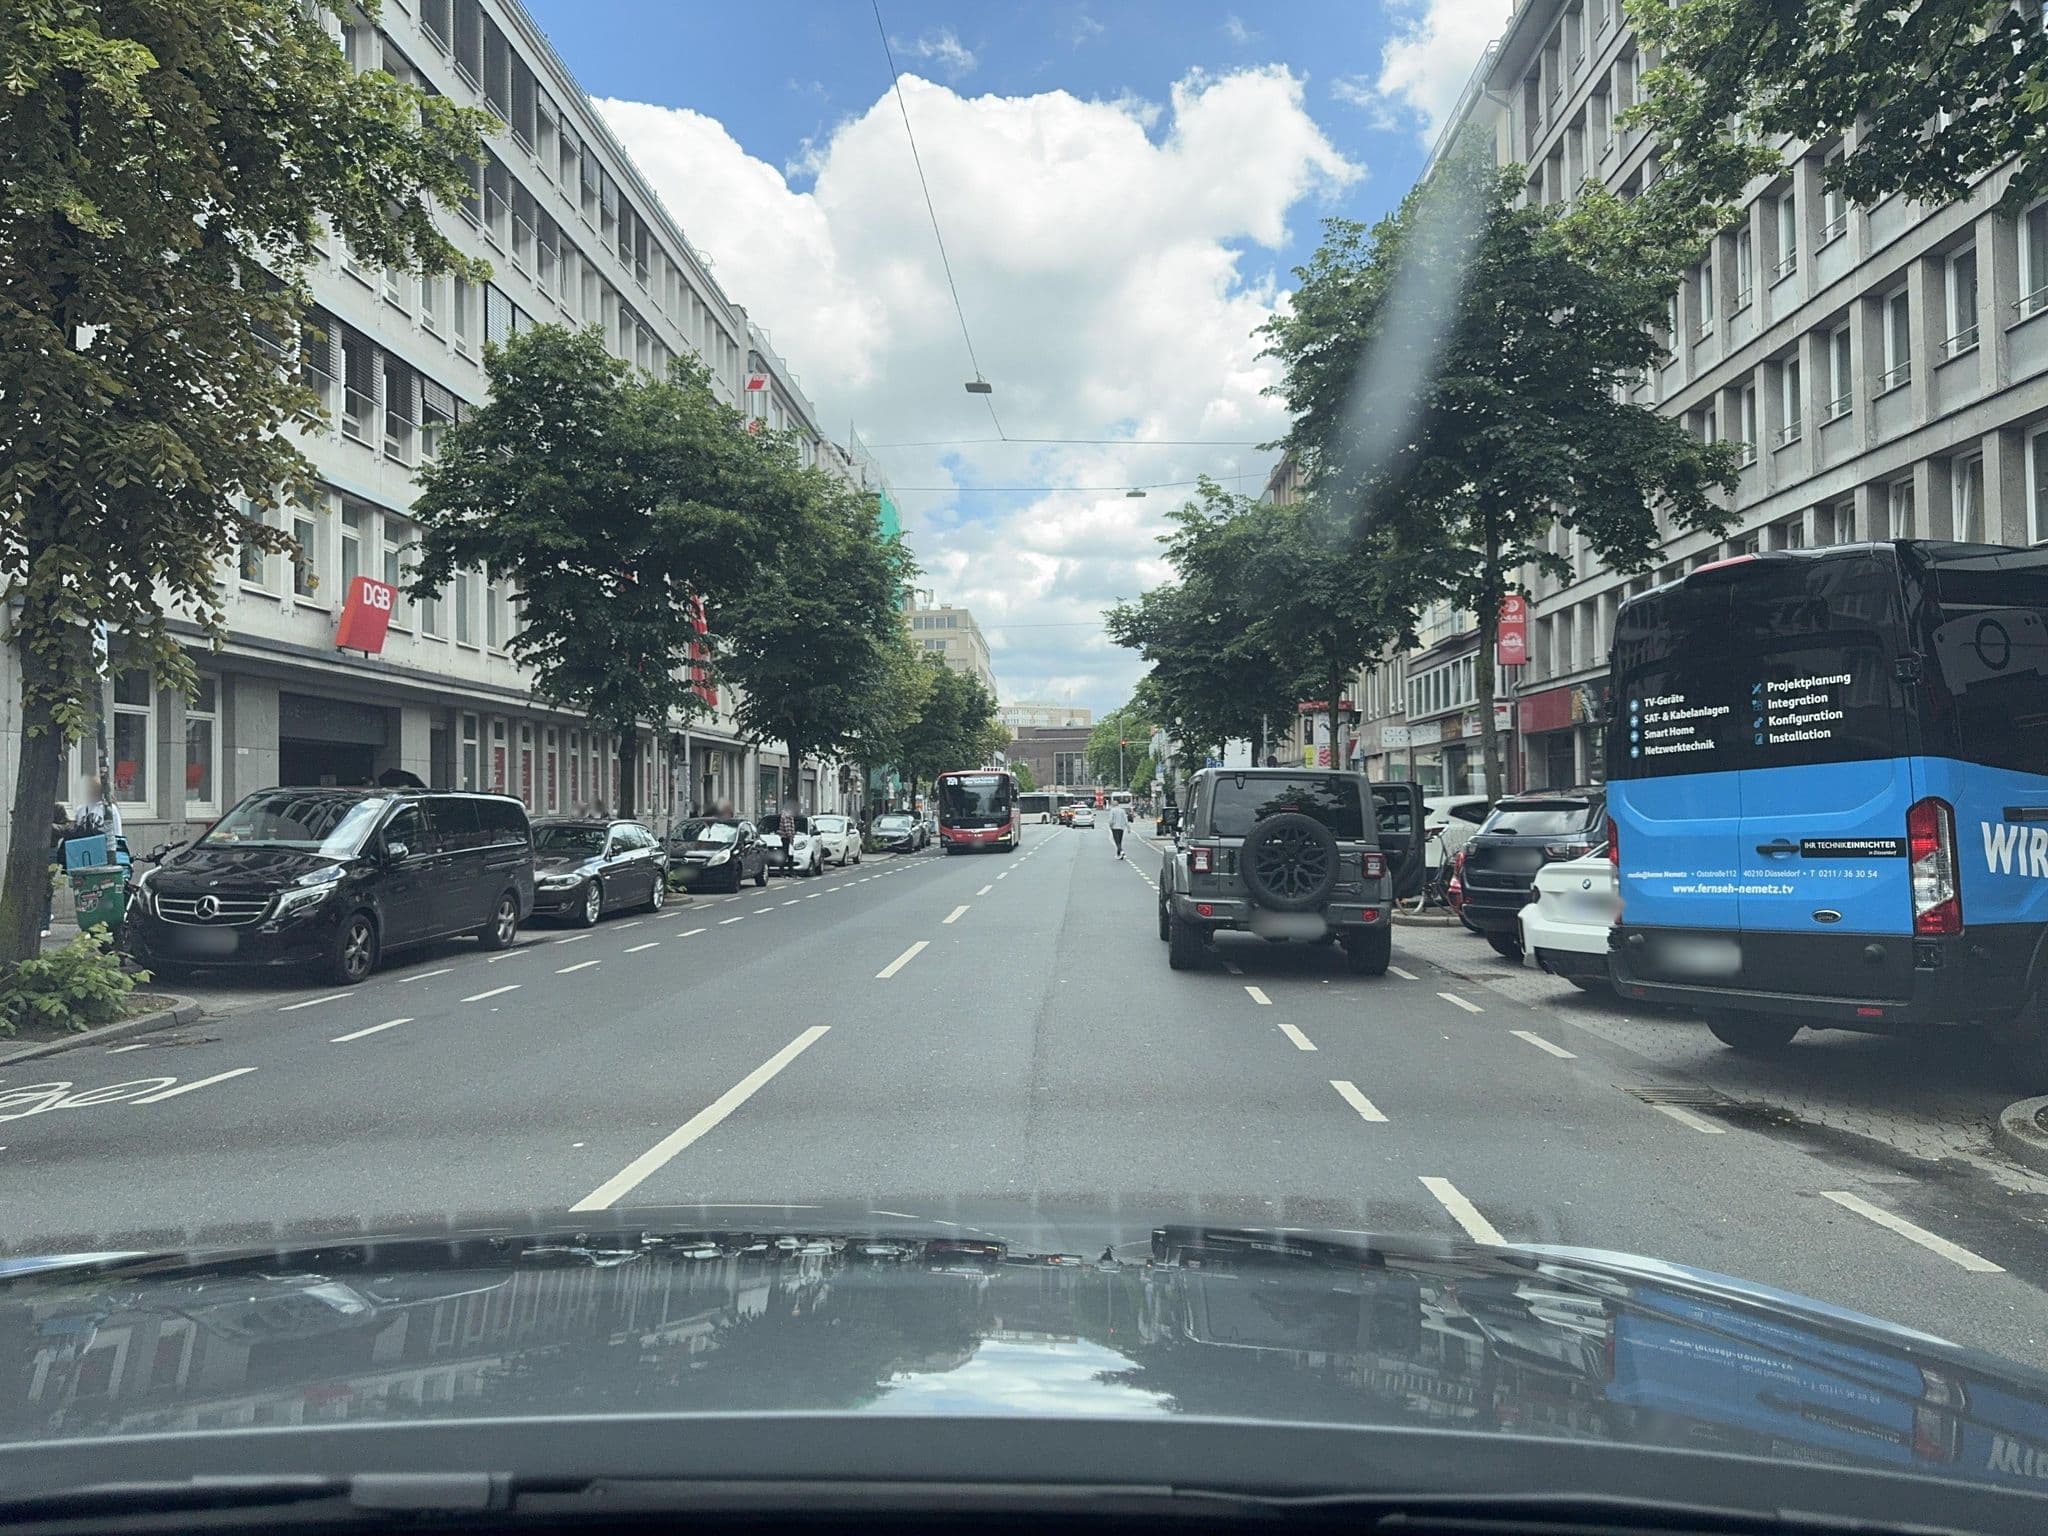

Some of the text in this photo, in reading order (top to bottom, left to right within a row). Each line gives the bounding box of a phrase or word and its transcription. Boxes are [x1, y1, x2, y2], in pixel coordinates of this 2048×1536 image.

[363, 582, 391, 610] DGB
[1767, 674, 1851, 692] Projektplanung
[1643, 694, 1685, 707] TV-Geräte
[1768, 694, 1828, 709] Integration
[1644, 706, 1730, 724] SAT- & Kabelanlagen
[1768, 710, 1843, 726] Konfiguration
[1644, 726, 1695, 739] Smart Home
[1769, 729, 1831, 743] Installation
[1644, 739, 1716, 755] Netzwerktechnik
[1804, 841, 1897, 849] IHR TECHNIKEINRICHTER
[1981, 821, 2048, 878] WIR
[1743, 869, 1764, 878] 40210
[1764, 869, 1801, 878] Düsseldorf
[1810, 869, 1816, 878] T
[1818, 869, 1837, 878] 0211
[1843, 869, 1853, 878] 36
[1855, 869, 1866, 878] 30
[1867, 869, 1878, 878] 54
[1672, 883, 1794, 895] www.fernseh-nemetz.tv
